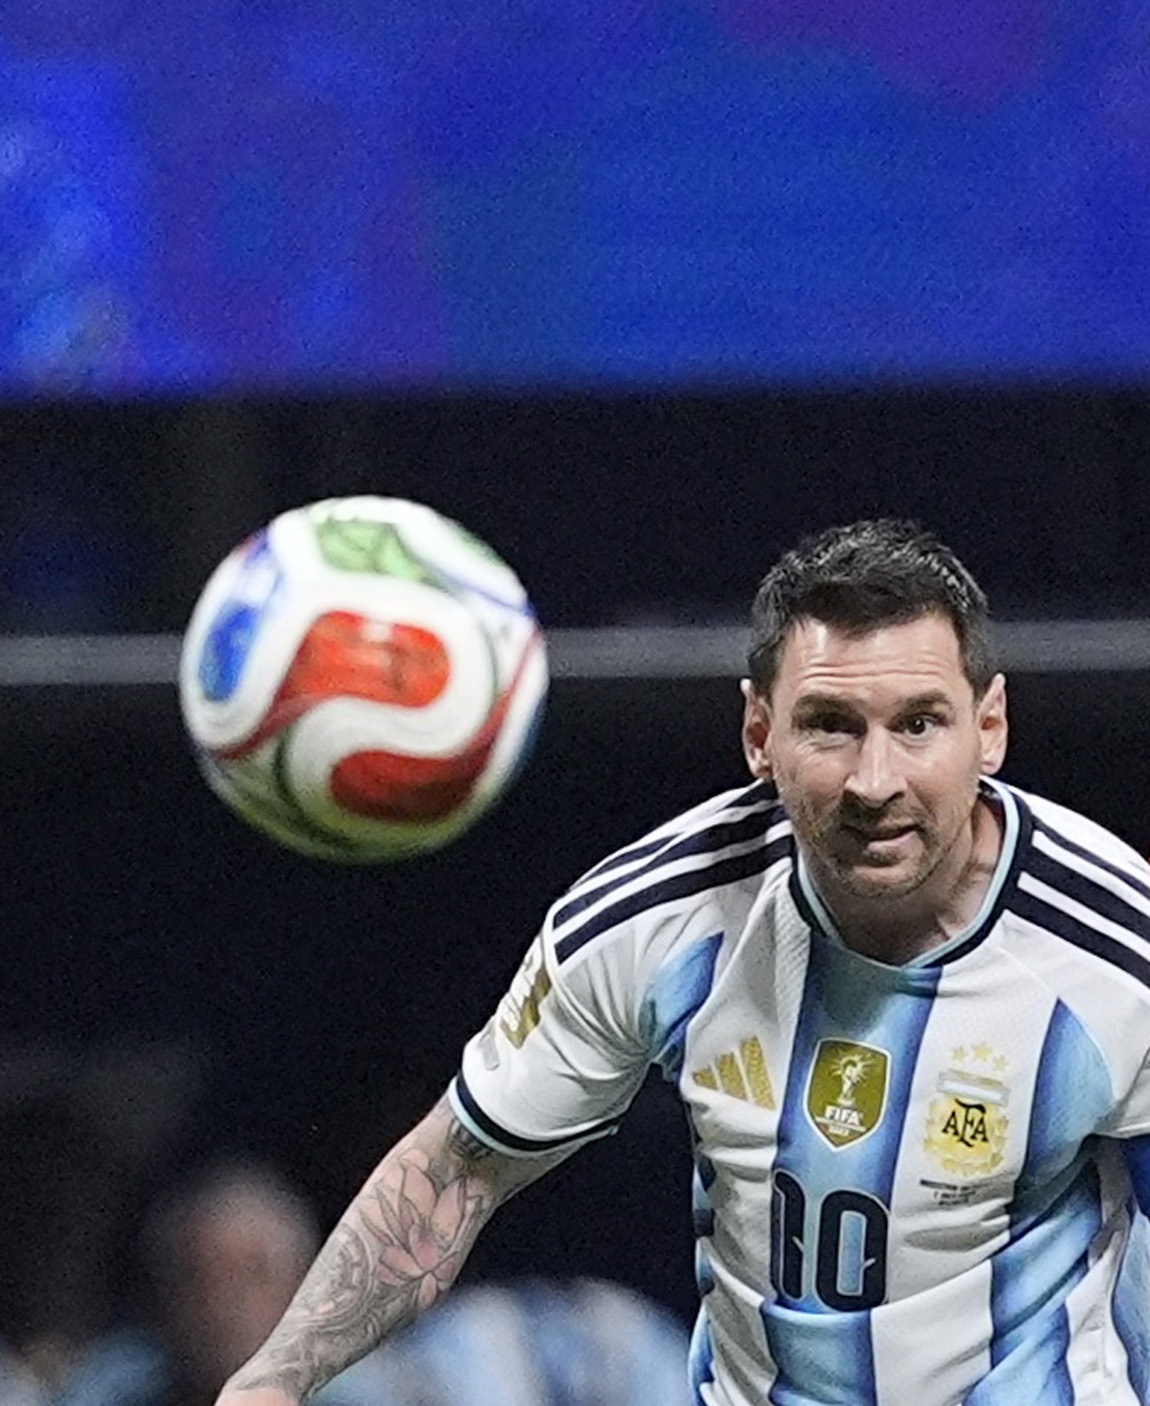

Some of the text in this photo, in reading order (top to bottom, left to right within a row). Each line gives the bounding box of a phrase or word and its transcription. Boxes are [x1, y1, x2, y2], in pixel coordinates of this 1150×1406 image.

[824, 1105, 860, 1127] FIFA
[941, 1098, 989, 1148] AFA
[772, 1168, 889, 1313] 10
